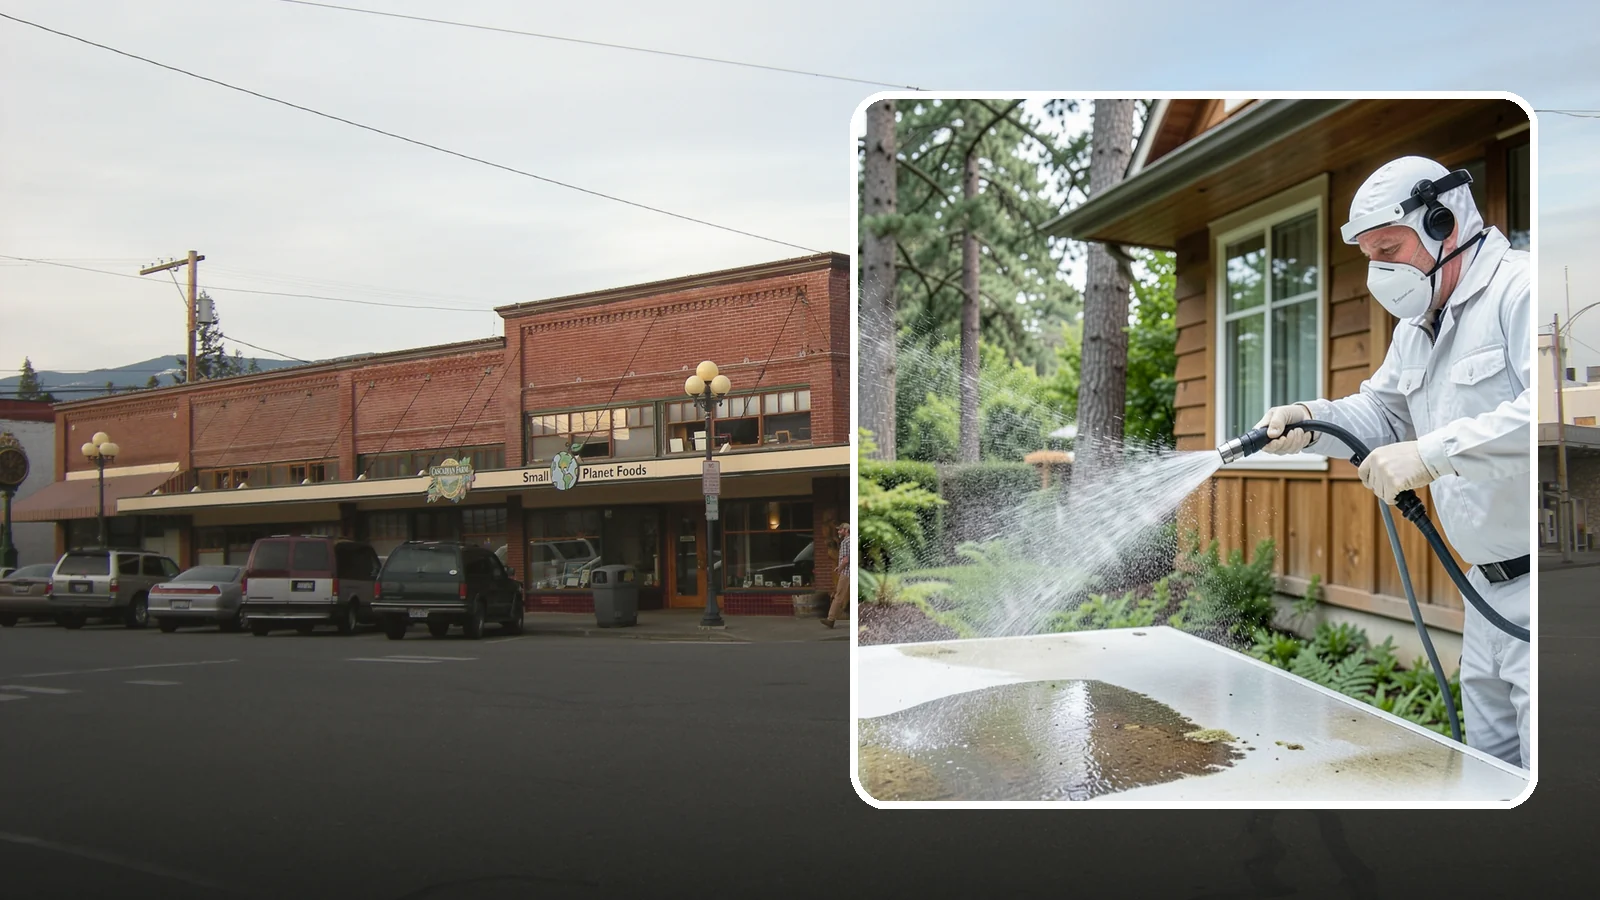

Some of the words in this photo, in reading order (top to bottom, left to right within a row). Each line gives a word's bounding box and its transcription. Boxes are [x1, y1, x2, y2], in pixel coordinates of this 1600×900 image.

[523, 471, 549, 482] Small
[582, 468, 614, 479] Planet
[616, 464, 647, 476] Foods
